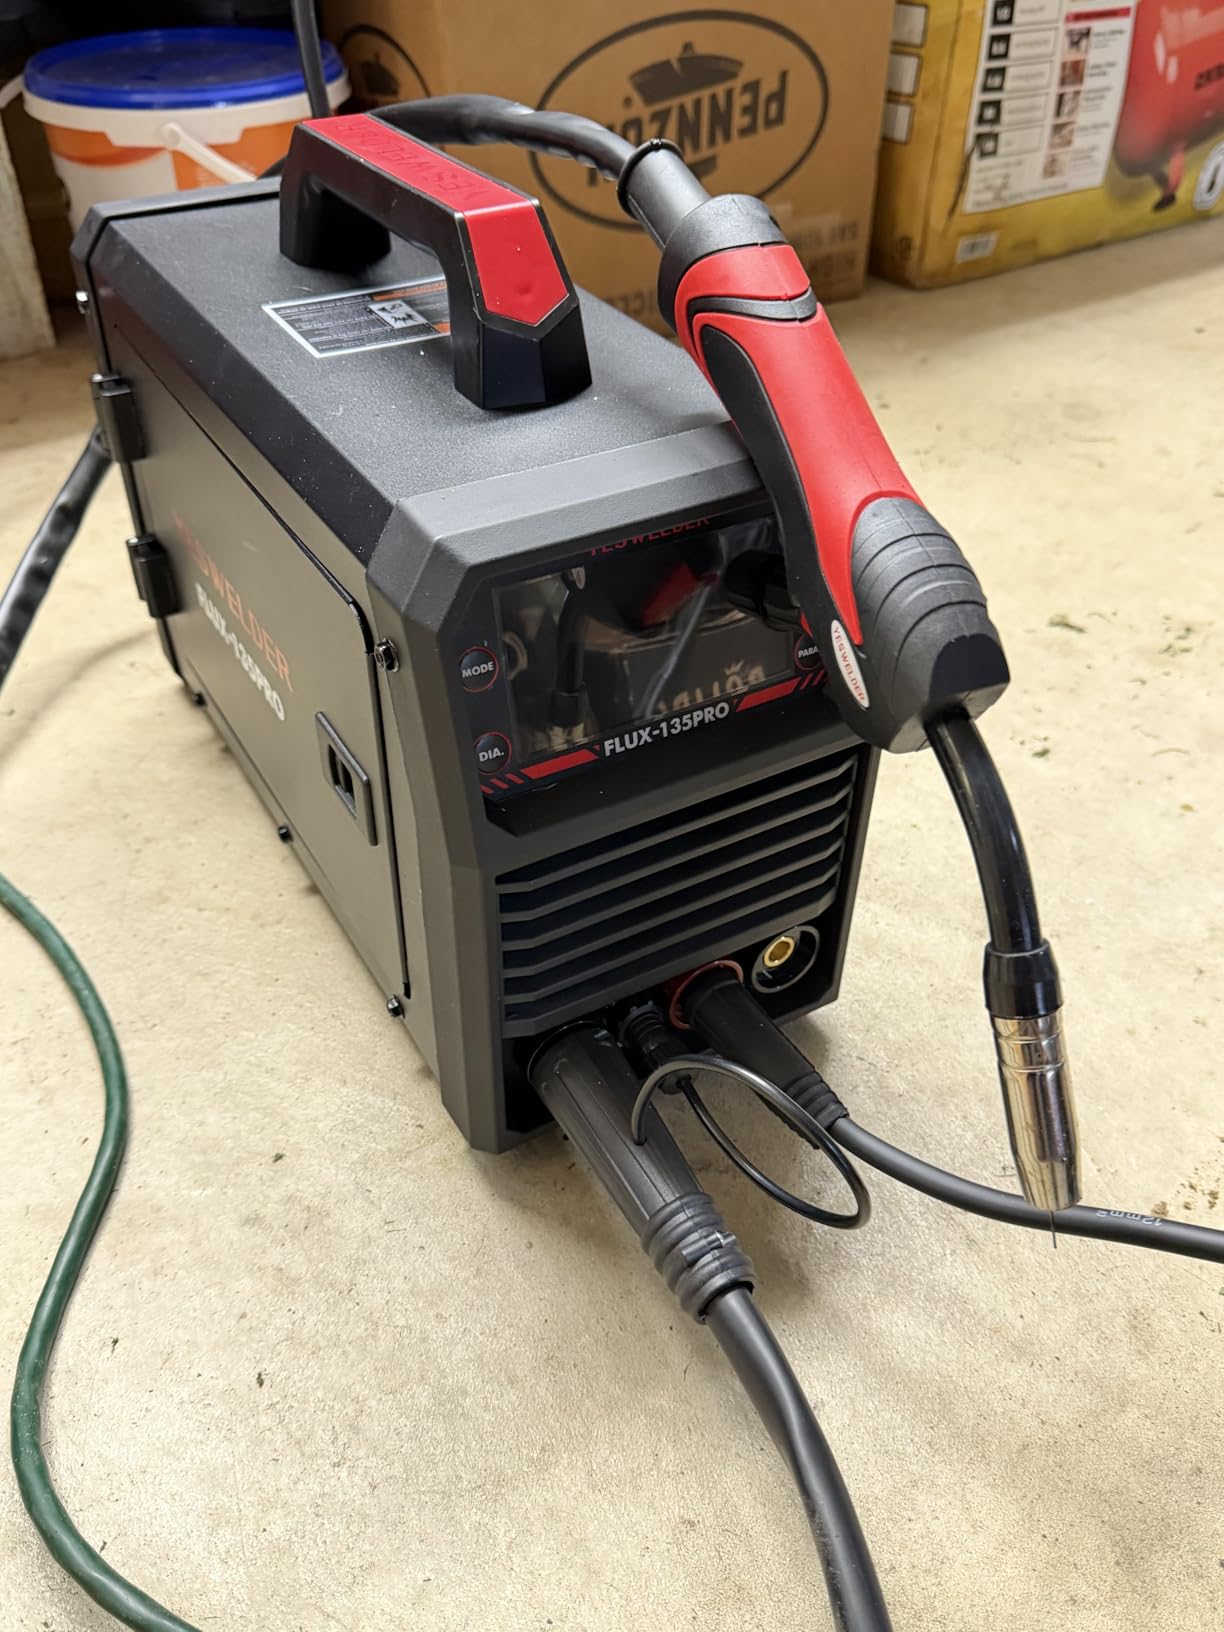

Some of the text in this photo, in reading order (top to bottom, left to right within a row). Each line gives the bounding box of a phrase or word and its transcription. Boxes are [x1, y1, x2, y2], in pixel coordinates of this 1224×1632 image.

[587, 71, 790, 187] PENNZO
[461, 660, 495, 679] MODE
[831, 624, 867, 702] YESWELDER
[478, 748, 505, 763] DIA.
[602, 700, 730, 757] FLUX-135PRO
